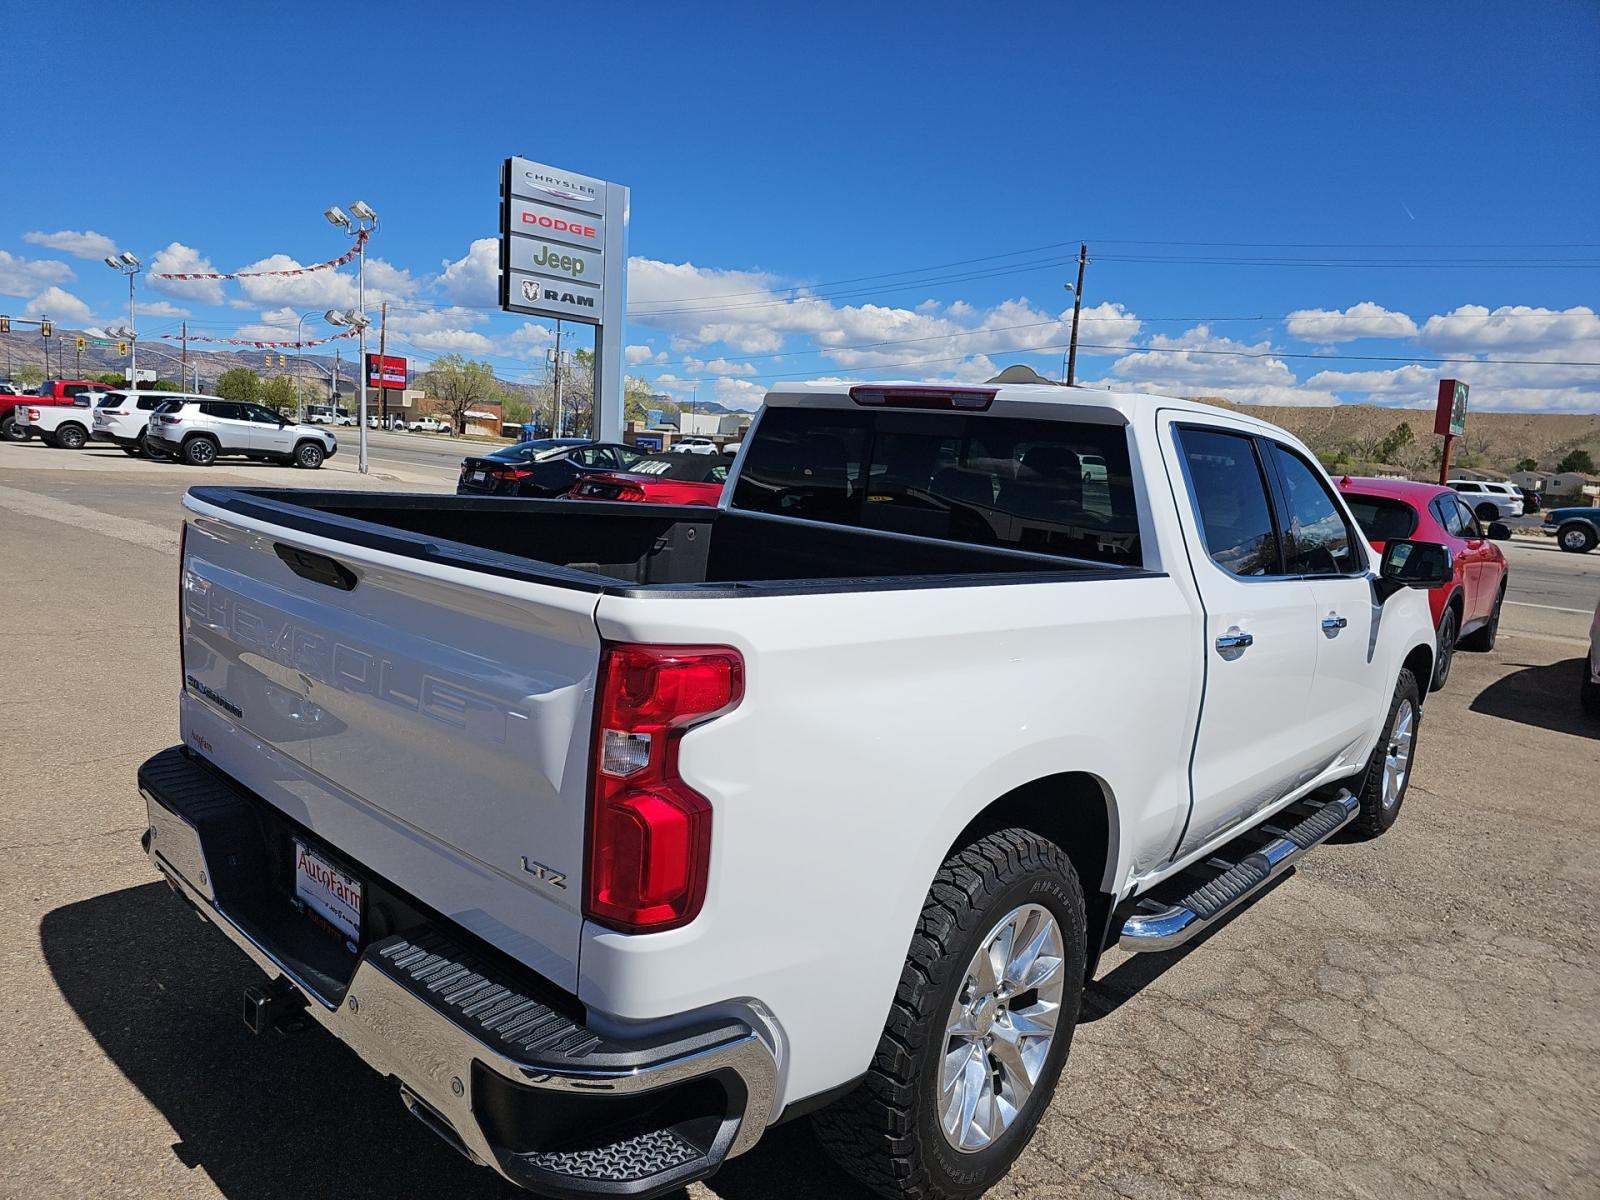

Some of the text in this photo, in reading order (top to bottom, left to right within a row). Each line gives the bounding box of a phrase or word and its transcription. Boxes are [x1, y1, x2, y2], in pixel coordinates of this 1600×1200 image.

[525, 171, 595, 194] CHRYSLER
[522, 212, 596, 238] DODGE
[533, 246, 585, 276] Jeep
[544, 289, 594, 307] RAM
[298, 851, 361, 909] AutoFarm
[520, 855, 567, 890] LTZ
